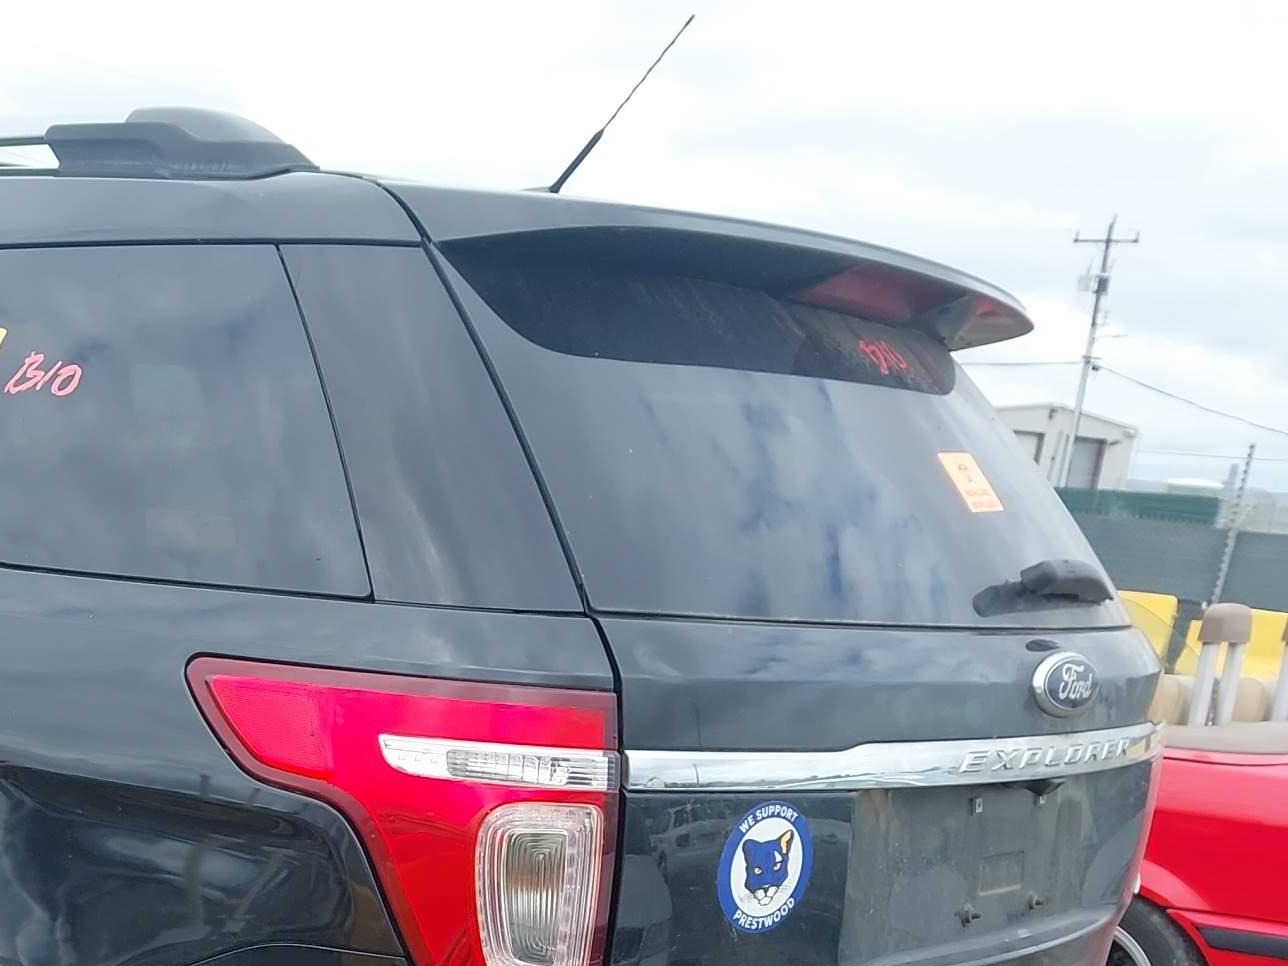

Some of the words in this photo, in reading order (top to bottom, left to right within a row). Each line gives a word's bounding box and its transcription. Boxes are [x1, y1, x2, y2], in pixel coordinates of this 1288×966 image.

[1058, 662, 1094, 700] Ford
[959, 738, 1130, 773] EXPLORER
[739, 815, 756, 833] WE
[756, 804, 799, 822] SUPPORT
[733, 898, 795, 929] PRESTWOOD
